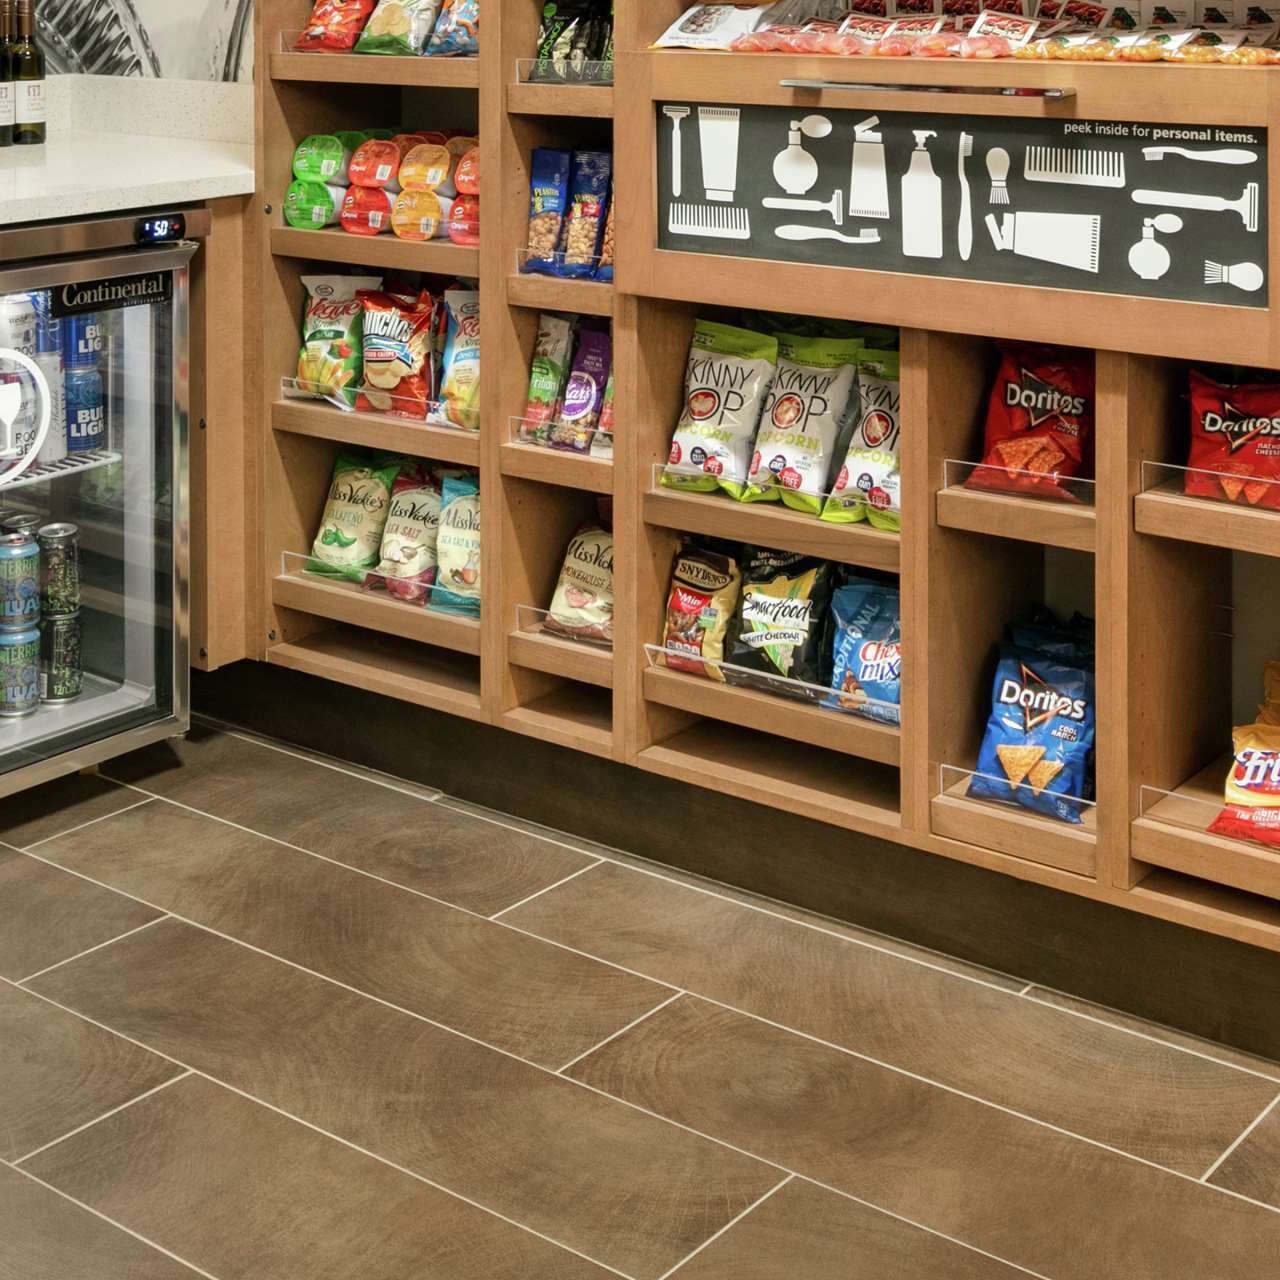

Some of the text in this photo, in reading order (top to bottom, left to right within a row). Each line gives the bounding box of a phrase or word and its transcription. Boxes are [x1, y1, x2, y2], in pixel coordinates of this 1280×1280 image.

[1064, 122, 1258, 144] peek inside for personal items.
[61, 273, 164, 307] Continental
[1006, 382, 1085, 416] Doritos
[743, 592, 813, 622] Smartfood
[999, 679, 1086, 720] Doritos
